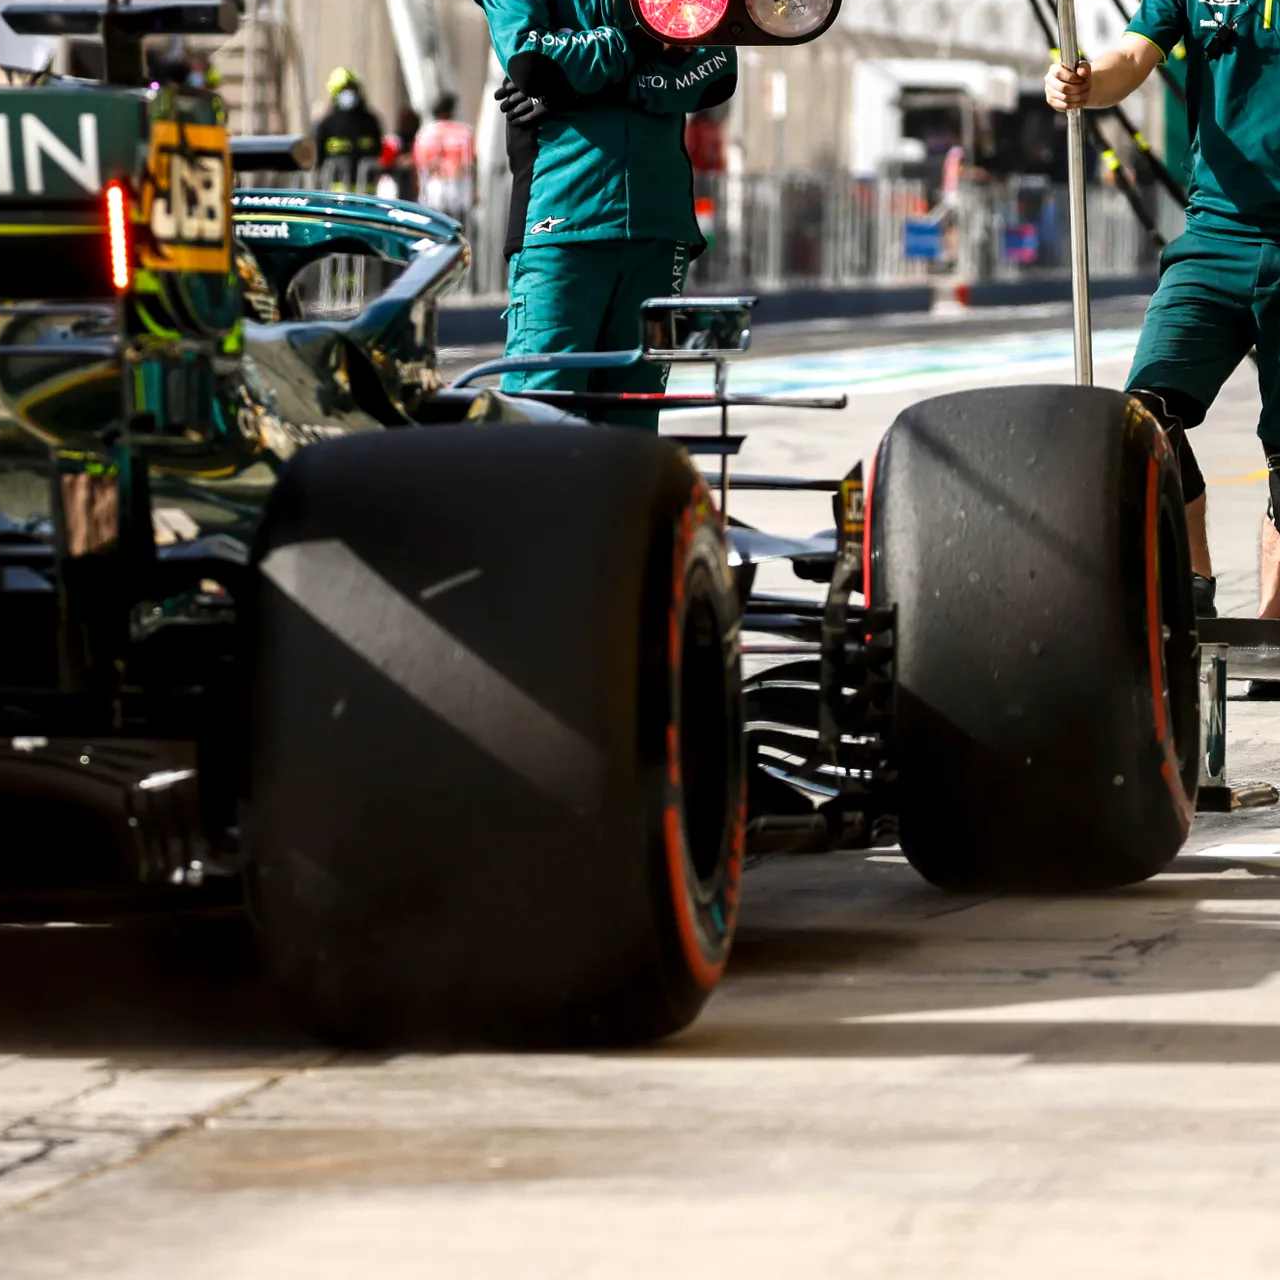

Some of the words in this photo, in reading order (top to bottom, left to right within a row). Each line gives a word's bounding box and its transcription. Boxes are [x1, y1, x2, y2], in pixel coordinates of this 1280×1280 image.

[675, 52, 728, 90] MARTIN
[241, 195, 310, 206] MARTIN
[235, 220, 290, 239] nizant
